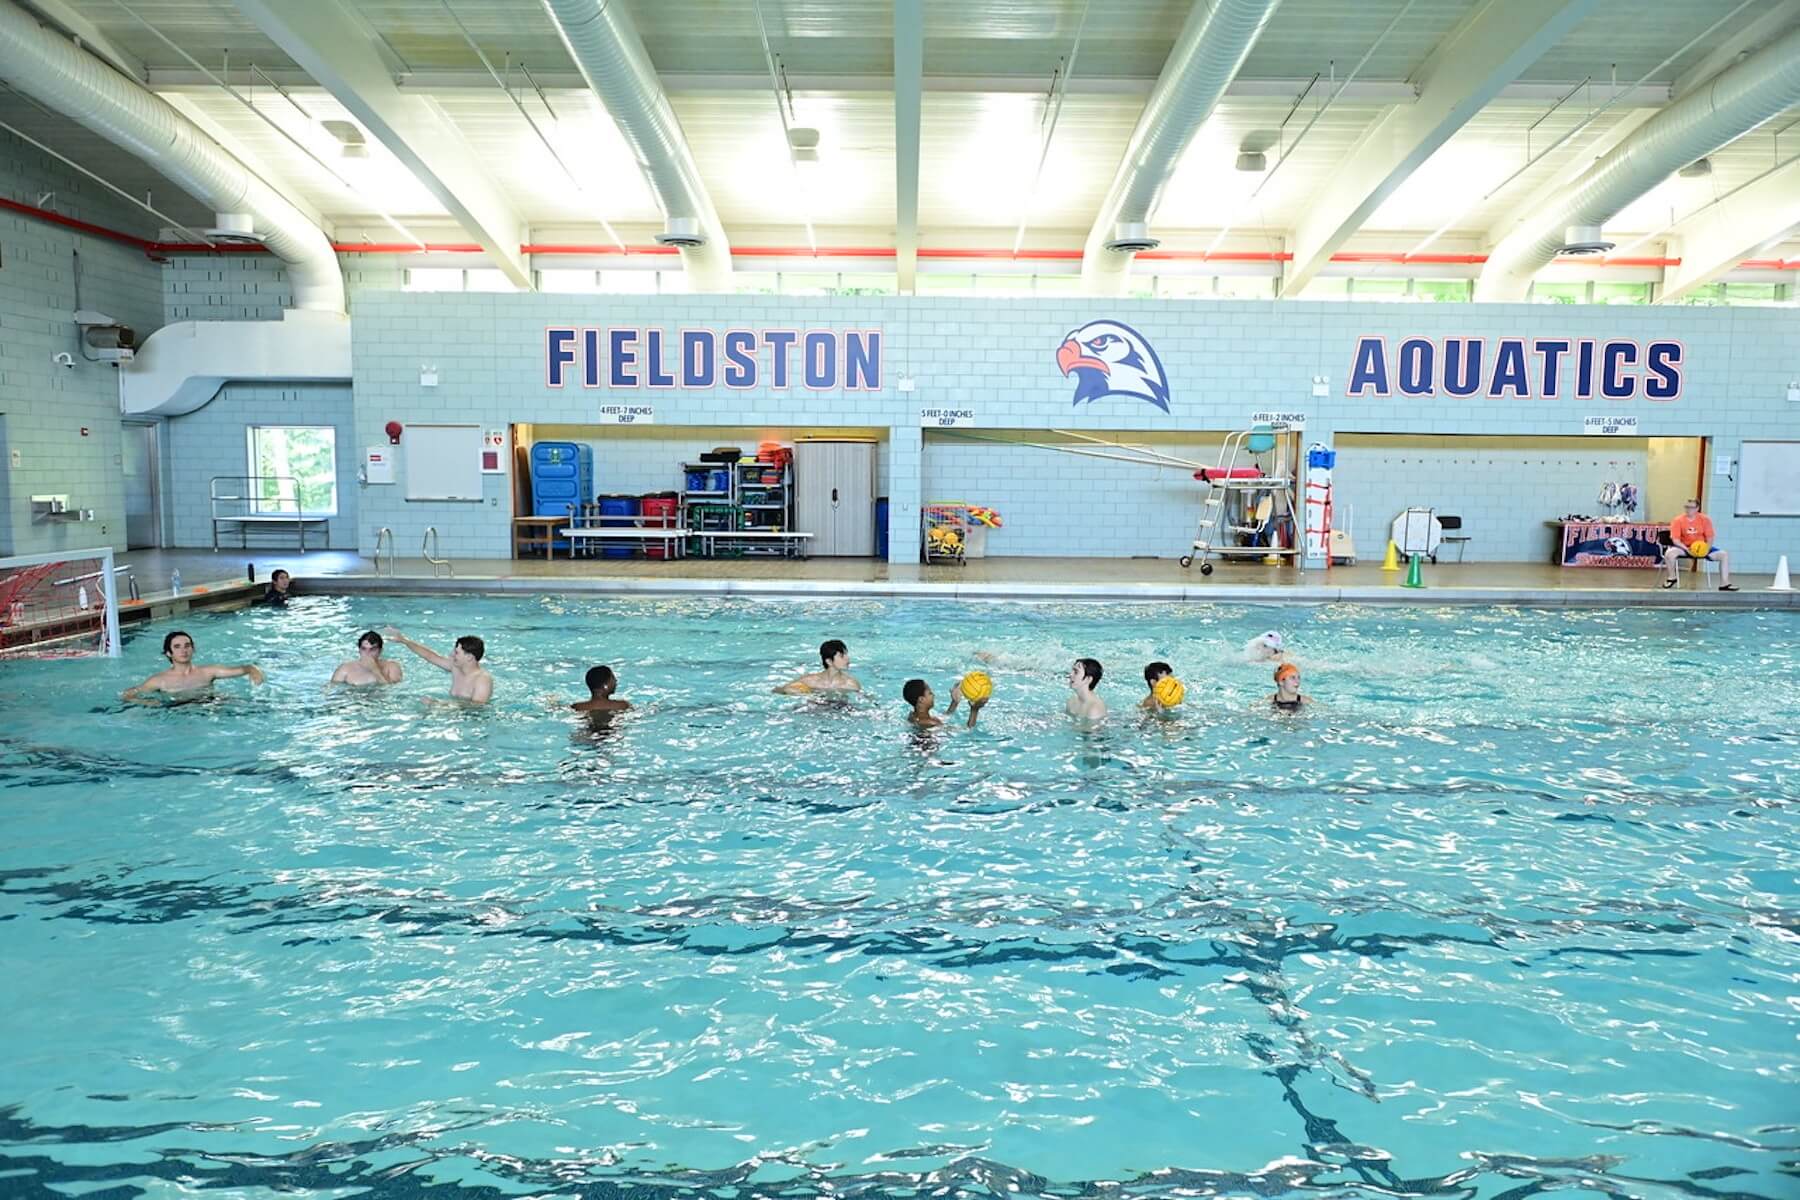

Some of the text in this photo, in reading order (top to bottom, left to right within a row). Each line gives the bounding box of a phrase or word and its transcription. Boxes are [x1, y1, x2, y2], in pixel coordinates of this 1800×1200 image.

[545, 327, 884, 391] FIELDSTON
[1345, 335, 1687, 401] AQUATICS
[600, 406, 605, 414] 4
[628, 406, 653, 416] INCHES
[921, 409, 926, 417] 5
[949, 409, 974, 418] INCHES
[618, 414, 635, 423] DEEP
[939, 417, 956, 426] DEEP
[1281, 413, 1306, 422] INCHES
[1612, 417, 1637, 426] INCHES
[1602, 425, 1619, 434] DEEP
